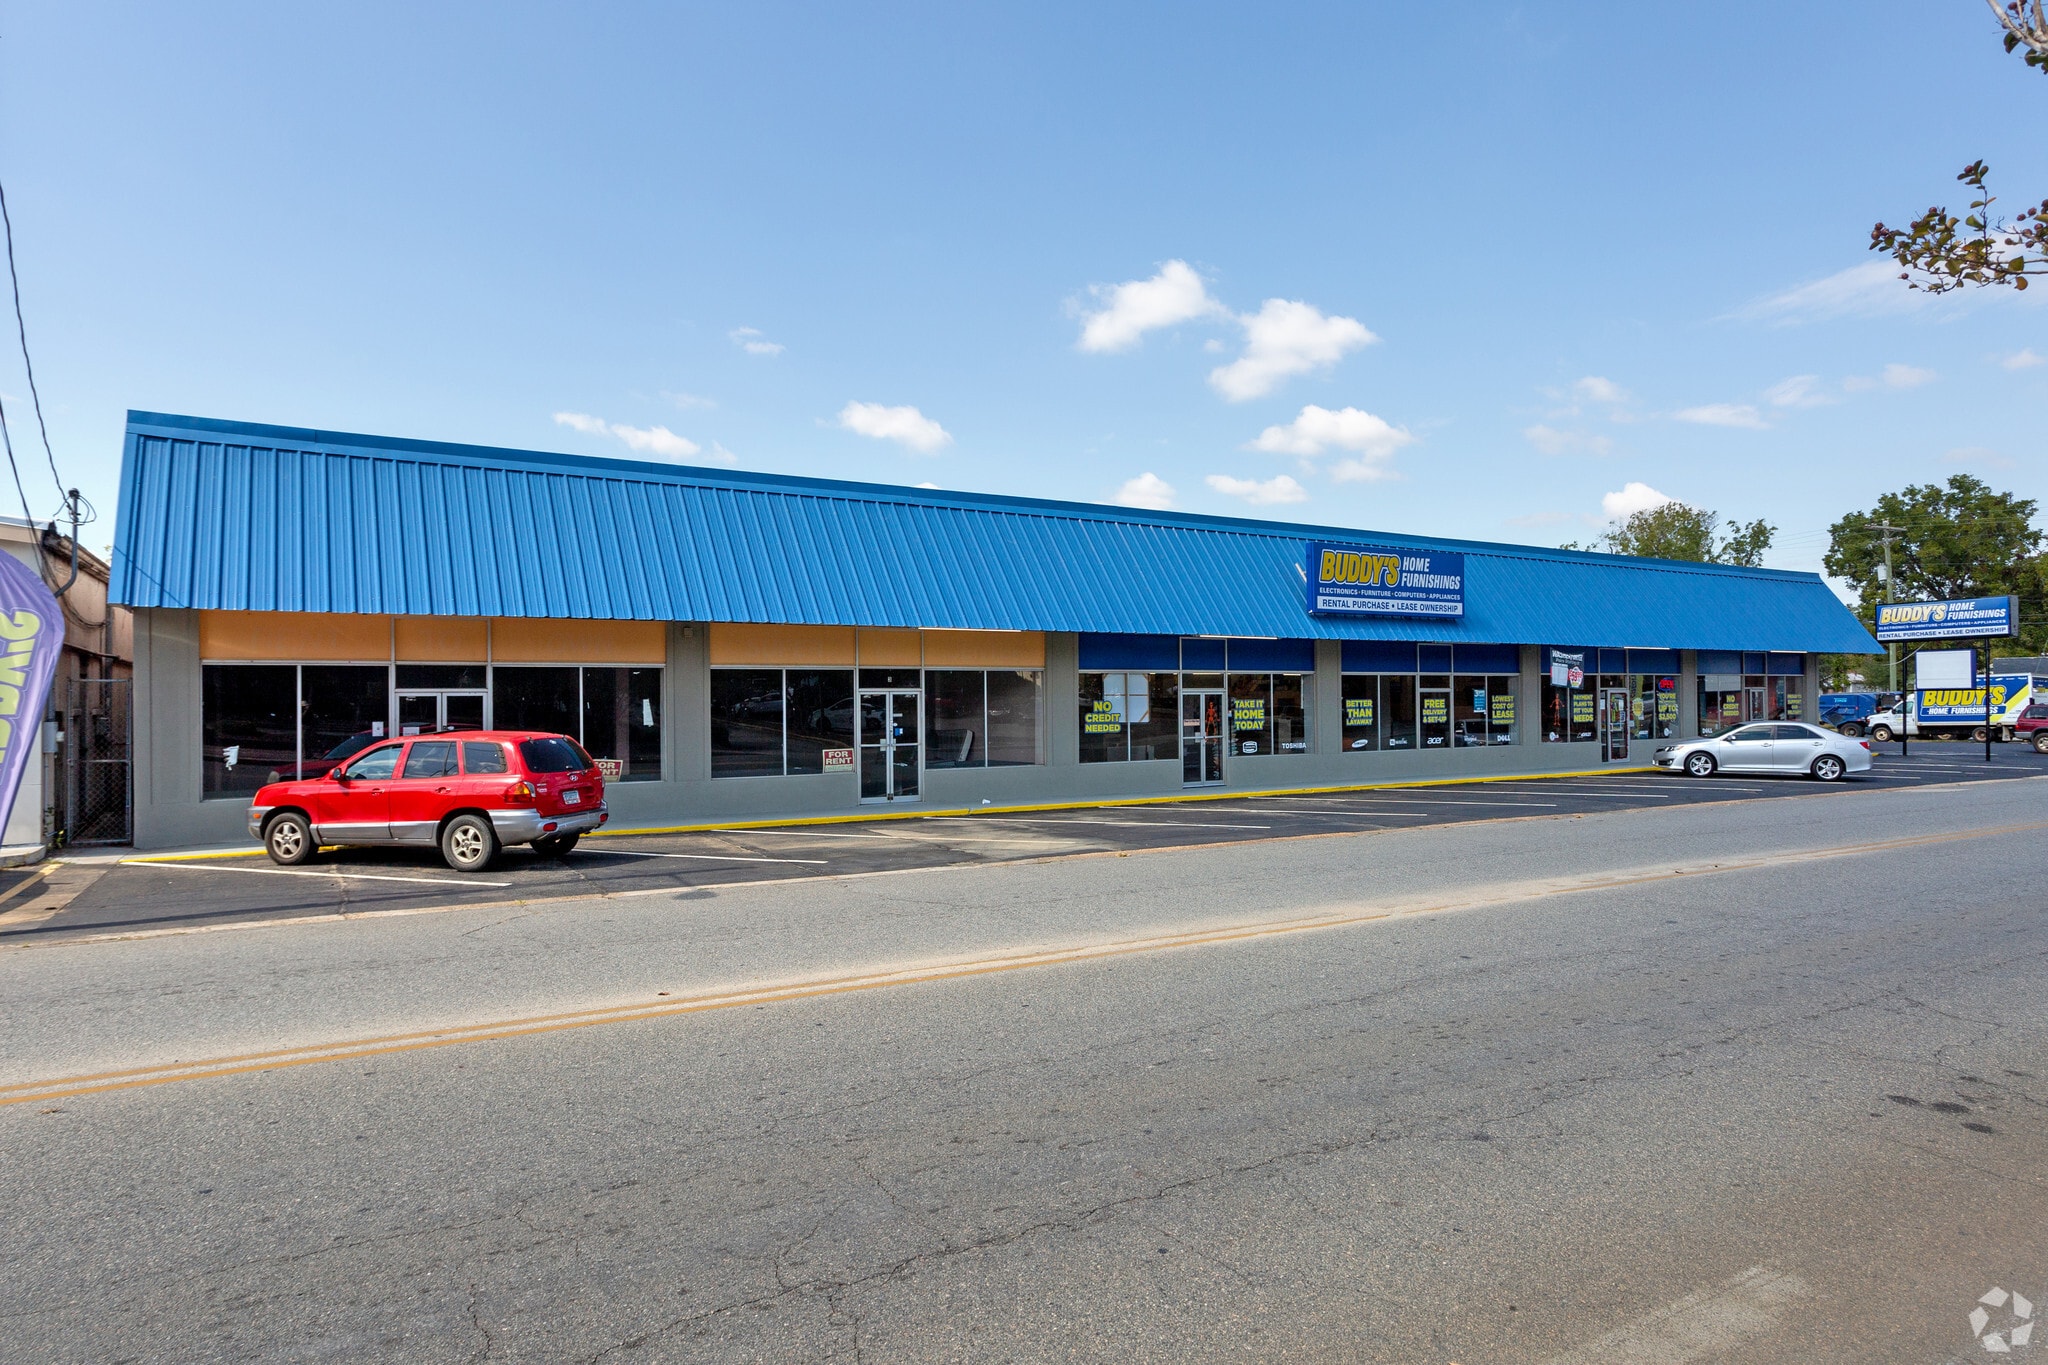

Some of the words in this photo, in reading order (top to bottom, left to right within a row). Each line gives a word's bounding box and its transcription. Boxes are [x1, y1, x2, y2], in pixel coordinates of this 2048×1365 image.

[1320, 550, 1400, 586] BUDDY'S
[1402, 556, 1430, 572] HOME
[1401, 573, 1461, 590] FURNISHINGS
[1319, 587, 1358, 595] ELECTRONICS
[1361, 589, 1391, 597] FURNITURE
[1394, 591, 1426, 599] COMPUTERS
[1429, 593, 1461, 601] APPLIANCES
[1322, 599, 1351, 608] RENTAL
[1352, 600, 1390, 610] PURCHASE
[1396, 602, 1418, 611] LEASE
[1419, 604, 1459, 613] OWNERSHIP
[1949, 601, 1976, 611] HOME
[1880, 604, 1946, 624] BUDDY'S
[1947, 608, 2007, 620] FURNISHINGS
[1903, 630, 1937, 638] PURCHASE
[1965, 626, 2007, 634] OWNERSHIP
[1922, 686, 2005, 706] BUDDY'S
[1093, 700, 1112, 712] NO
[1234, 700, 1255, 708] TAKE
[1256, 699, 1264, 708] IT
[1346, 699, 1373, 708] BETTER
[1424, 699, 1446, 708] FREE
[1234, 709, 1264, 719] HOME
[1347, 708, 1373, 718] THAN
[1492, 710, 1515, 719] LEASE
[1928, 707, 1949, 715] HOME
[1085, 713, 1120, 722] CREDIT
[1346, 718, 1373, 726] LAYAWAY
[1573, 714, 1594, 722] NEEDS
[1085, 723, 1121, 732] NEEDED
[1234, 720, 1264, 730] TODAY
[1282, 742, 1307, 750] TOSHIBA
[1427, 737, 1444, 745] acer
[826, 757, 852, 765] RENT
